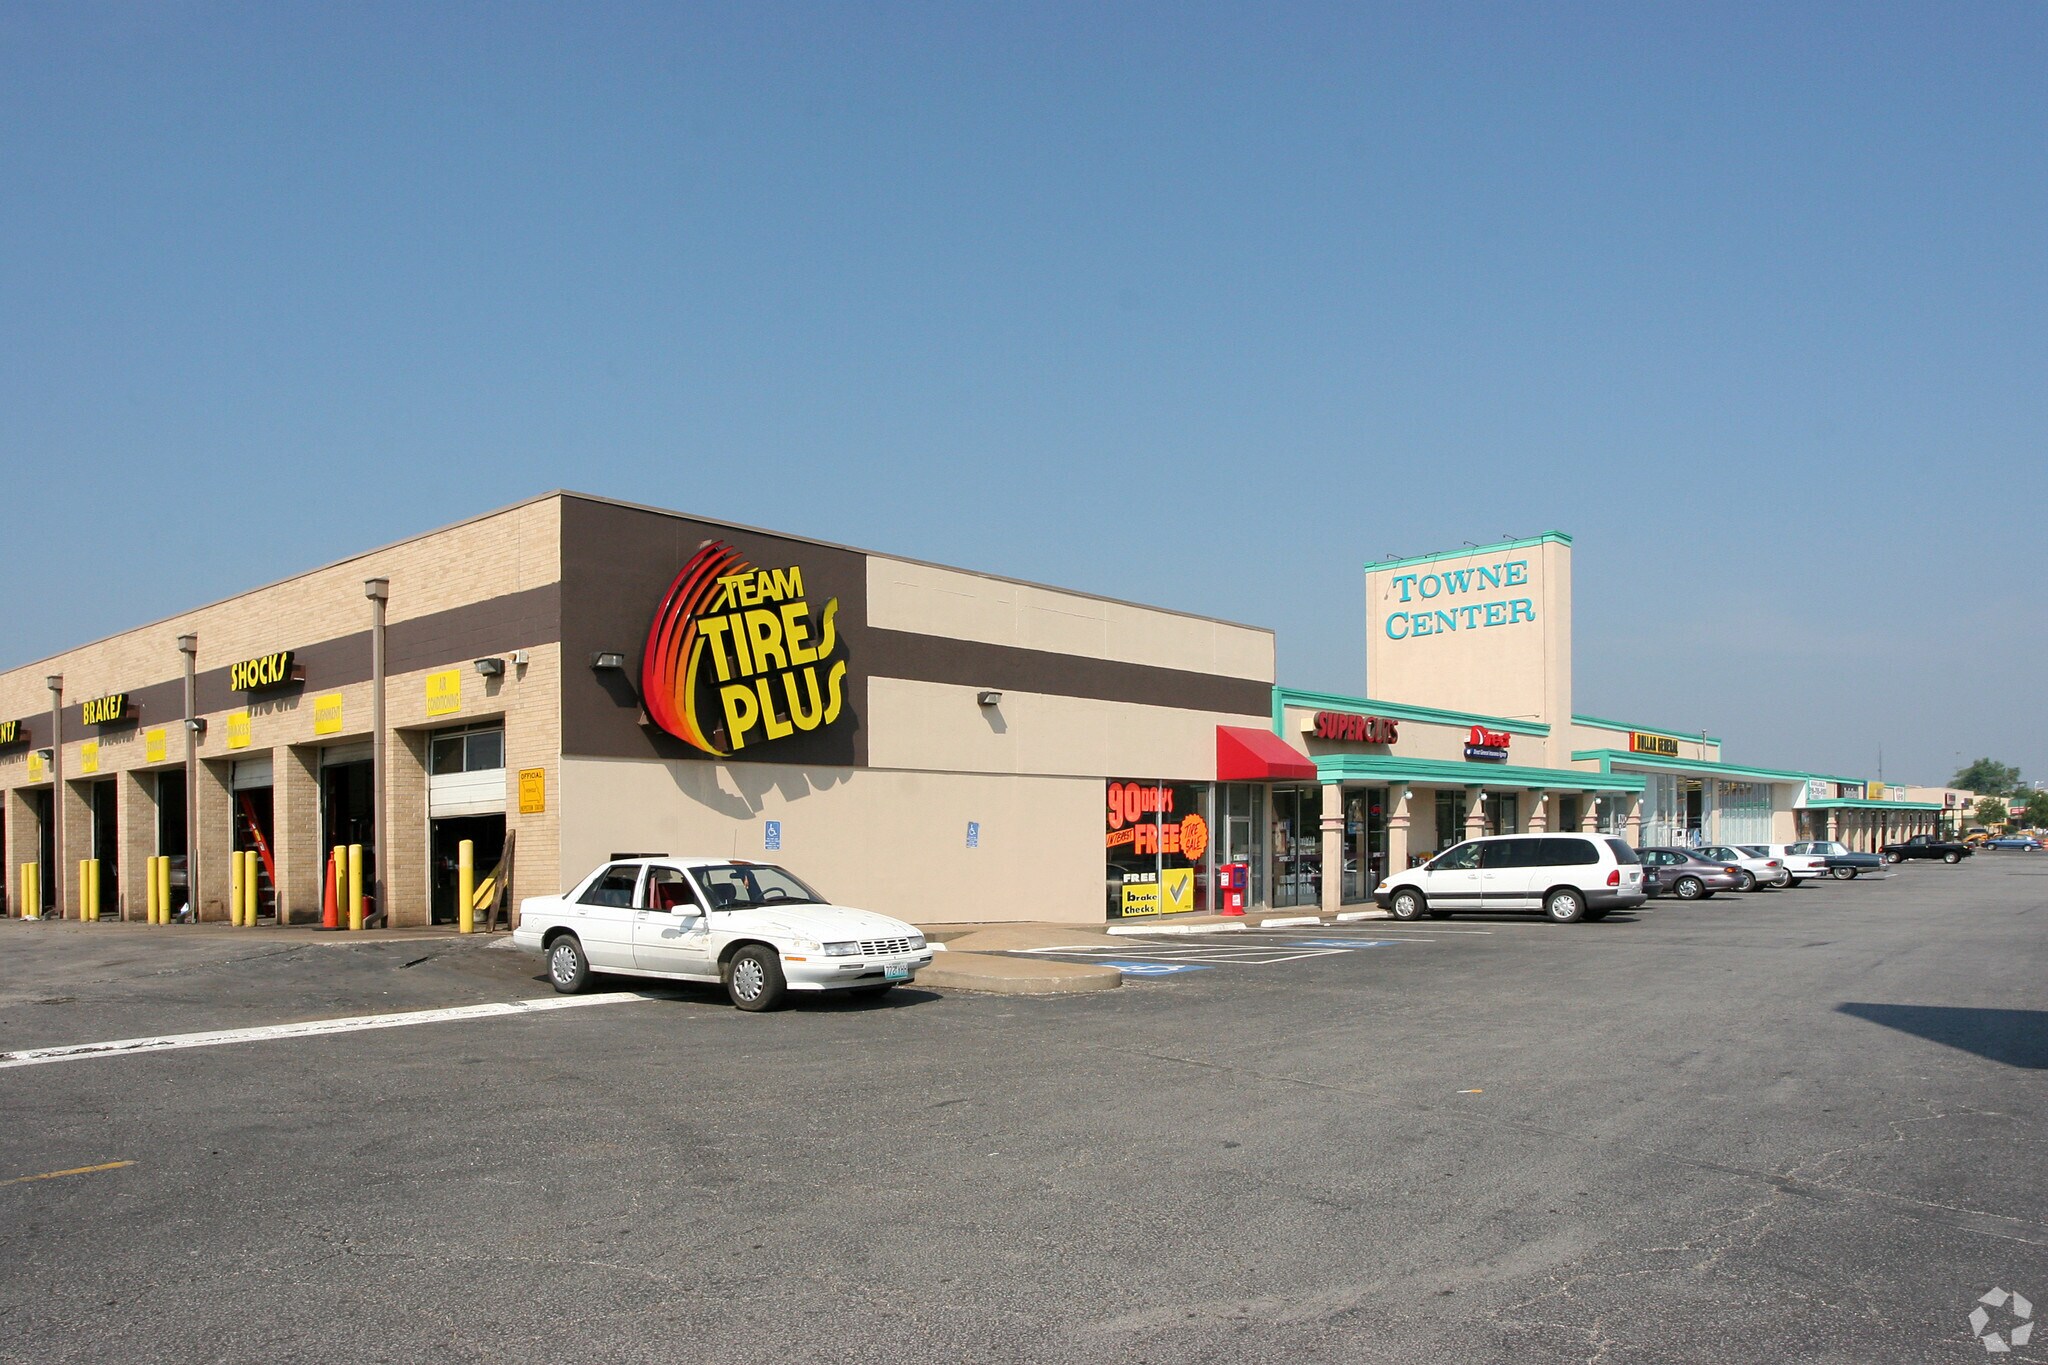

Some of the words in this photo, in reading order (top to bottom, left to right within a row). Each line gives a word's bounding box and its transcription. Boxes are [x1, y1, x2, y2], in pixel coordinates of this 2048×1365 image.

[717, 565, 804, 608] TEAM
[1393, 560, 1527, 602] TOWNE
[1386, 598, 1536, 639] CENTER
[698, 597, 839, 682] TIRES
[231, 651, 287, 692] SHOCKS
[83, 695, 122, 725] BRAKES
[720, 660, 846, 750] PLUS
[1314, 711, 1398, 744] SUPERCUTS
[520, 771, 542, 780] OFFICIAL
[1108, 782, 1141, 829] 90
[1142, 786, 1173, 813] DAYS
[1134, 823, 1180, 854] FREE
[1123, 872, 1156, 883] FREE
